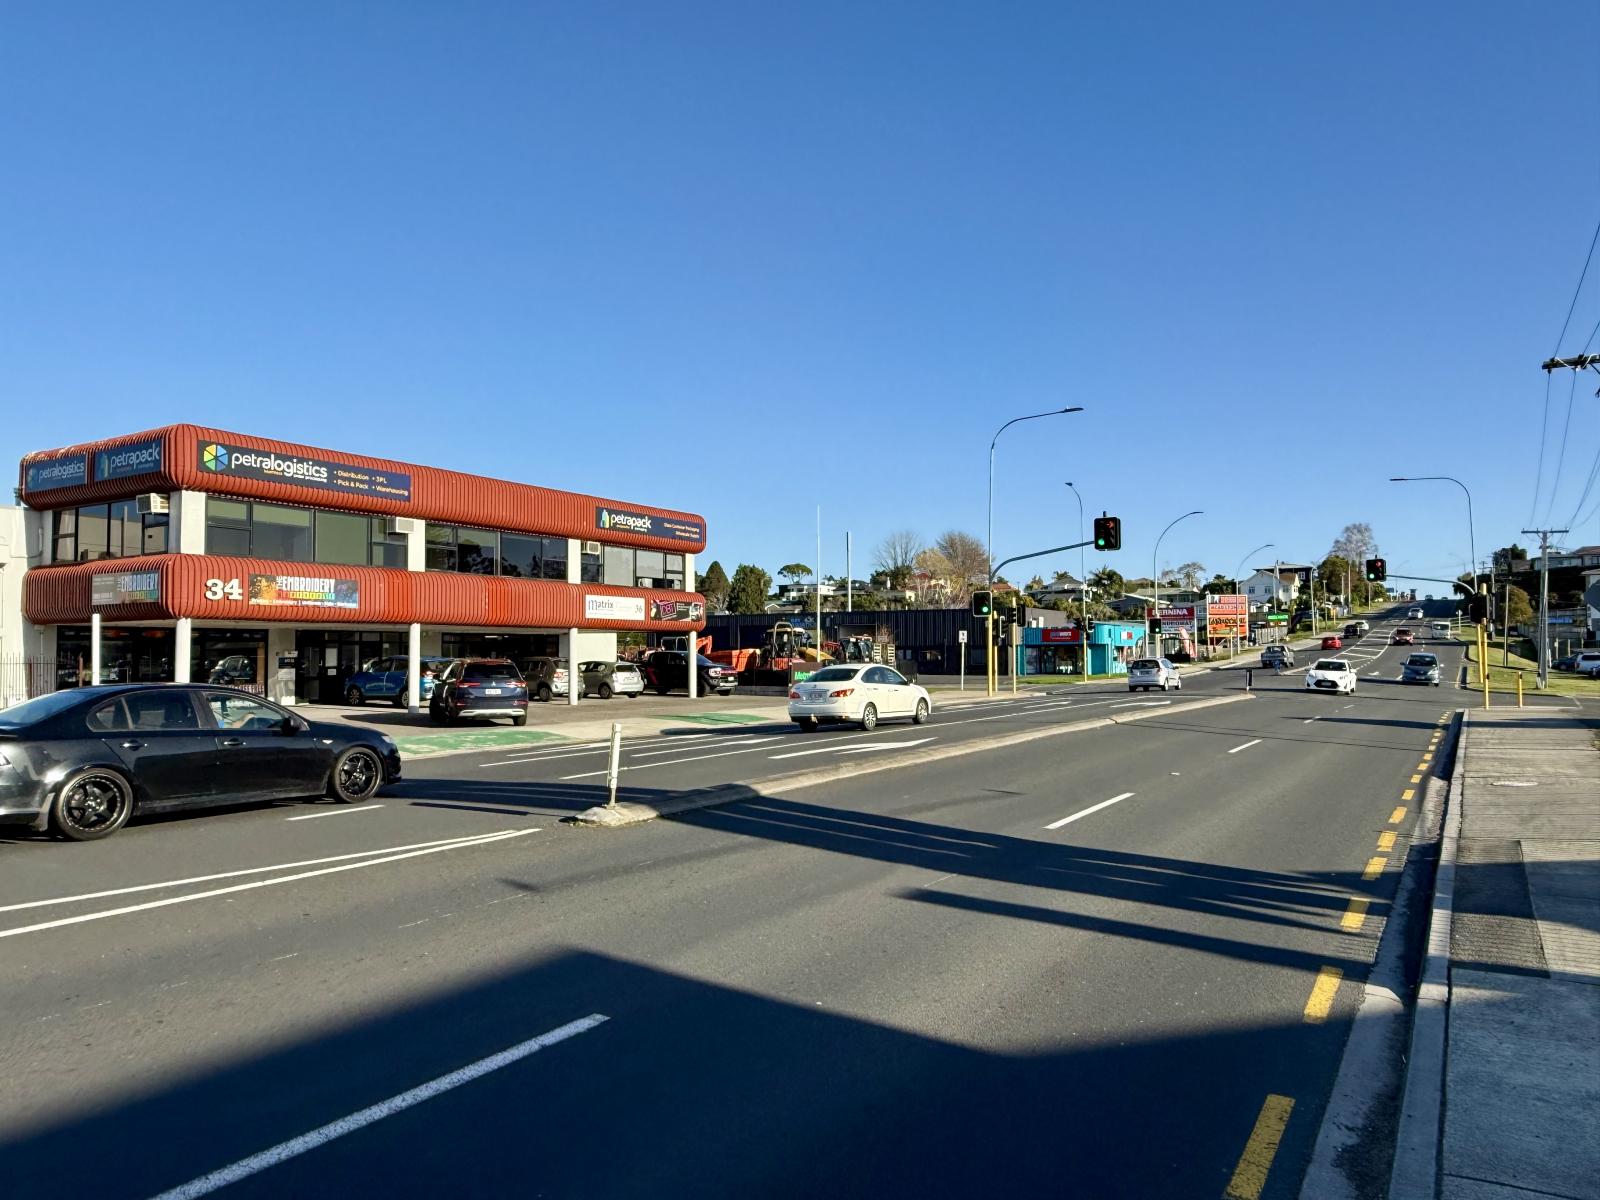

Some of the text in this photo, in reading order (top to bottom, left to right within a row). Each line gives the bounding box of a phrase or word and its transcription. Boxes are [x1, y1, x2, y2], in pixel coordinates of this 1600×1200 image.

[110, 443, 160, 474] petrapack
[231, 453, 328, 478] petralogistics
[39, 461, 84, 484] petralogistics
[337, 470, 370, 480] Distribution
[337, 479, 350, 487] Pick
[355, 481, 369, 490] Pack
[375, 485, 409, 497] Warehousing
[610, 513, 652, 530] petrapack
[121, 573, 159, 592] EMBROIDERY
[205, 578, 243, 601] 34
[282, 575, 336, 593] EMBROIDERY
[634, 604, 643, 614] 36
